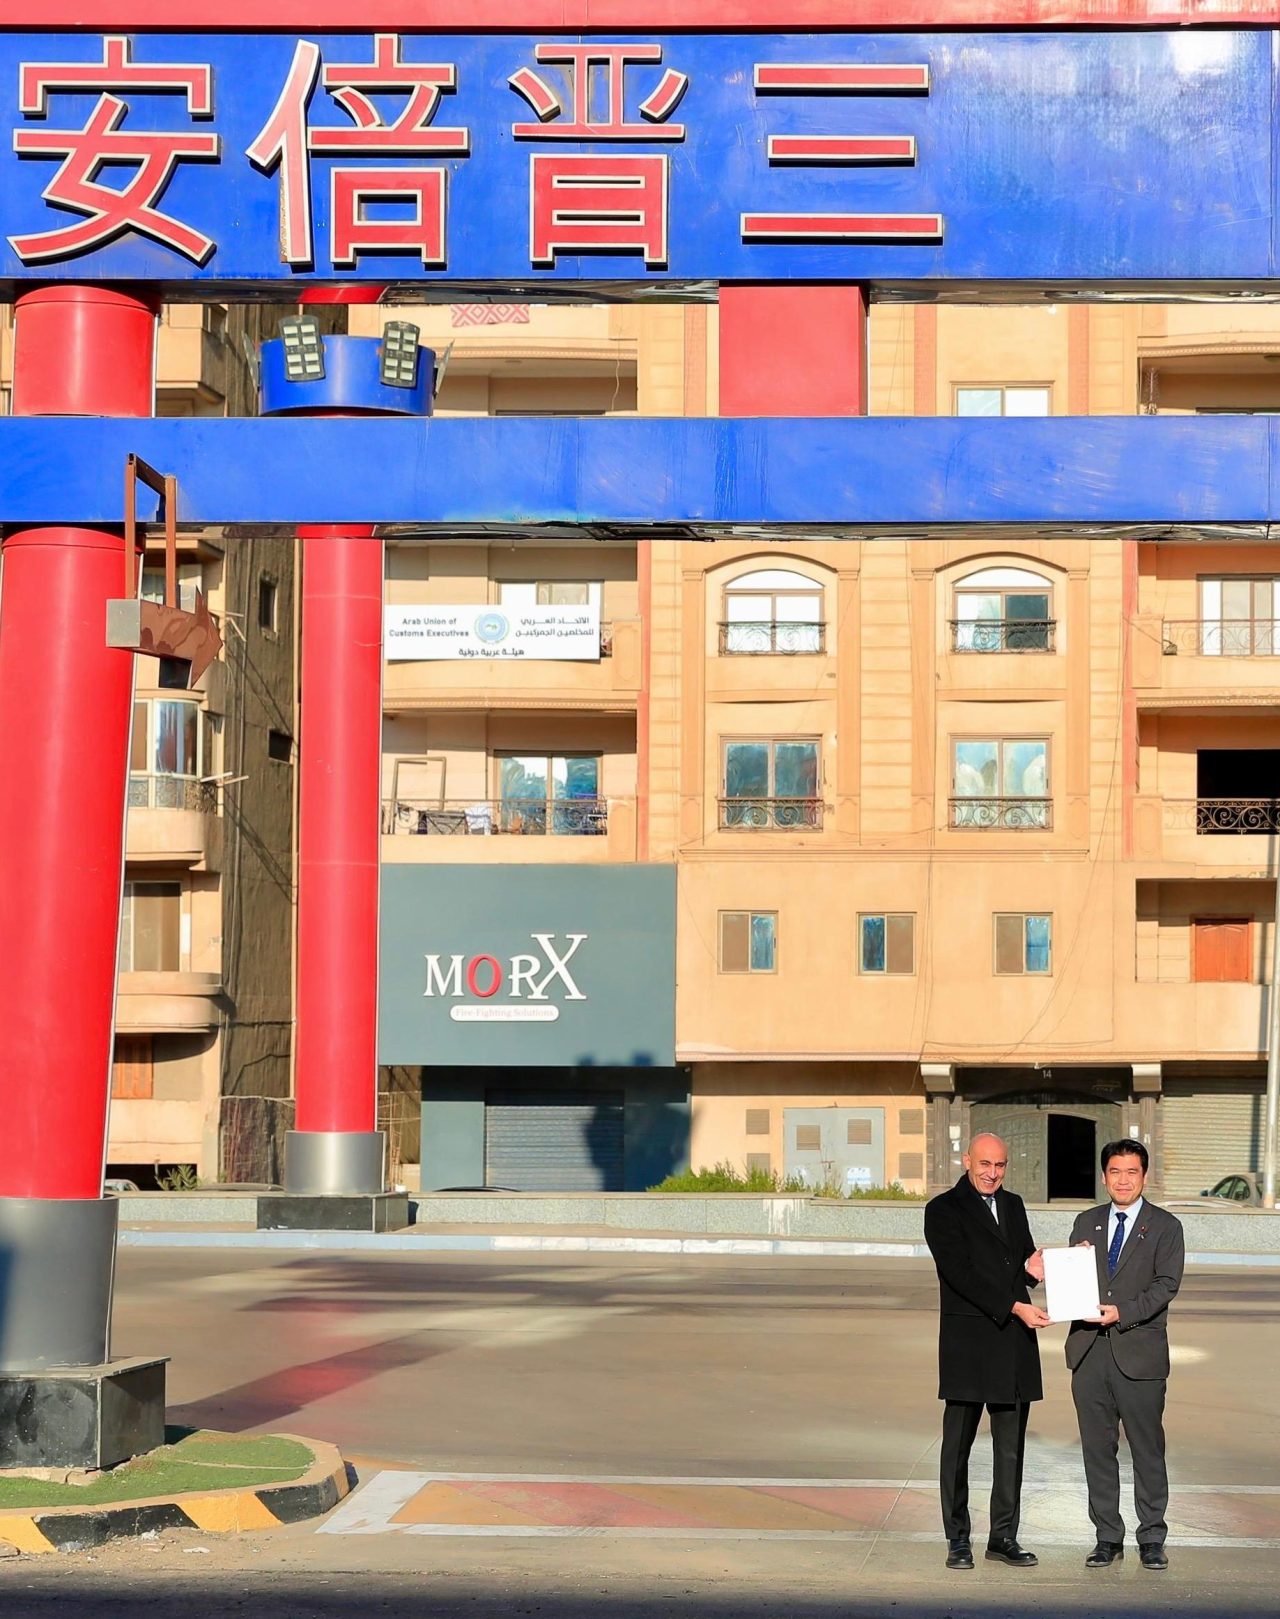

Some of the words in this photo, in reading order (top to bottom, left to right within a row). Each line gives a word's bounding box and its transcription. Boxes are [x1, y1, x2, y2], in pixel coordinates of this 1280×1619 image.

[7, 33, 943, 271] 安倍晋三
[1042, 1069, 1052, 1079] 14
